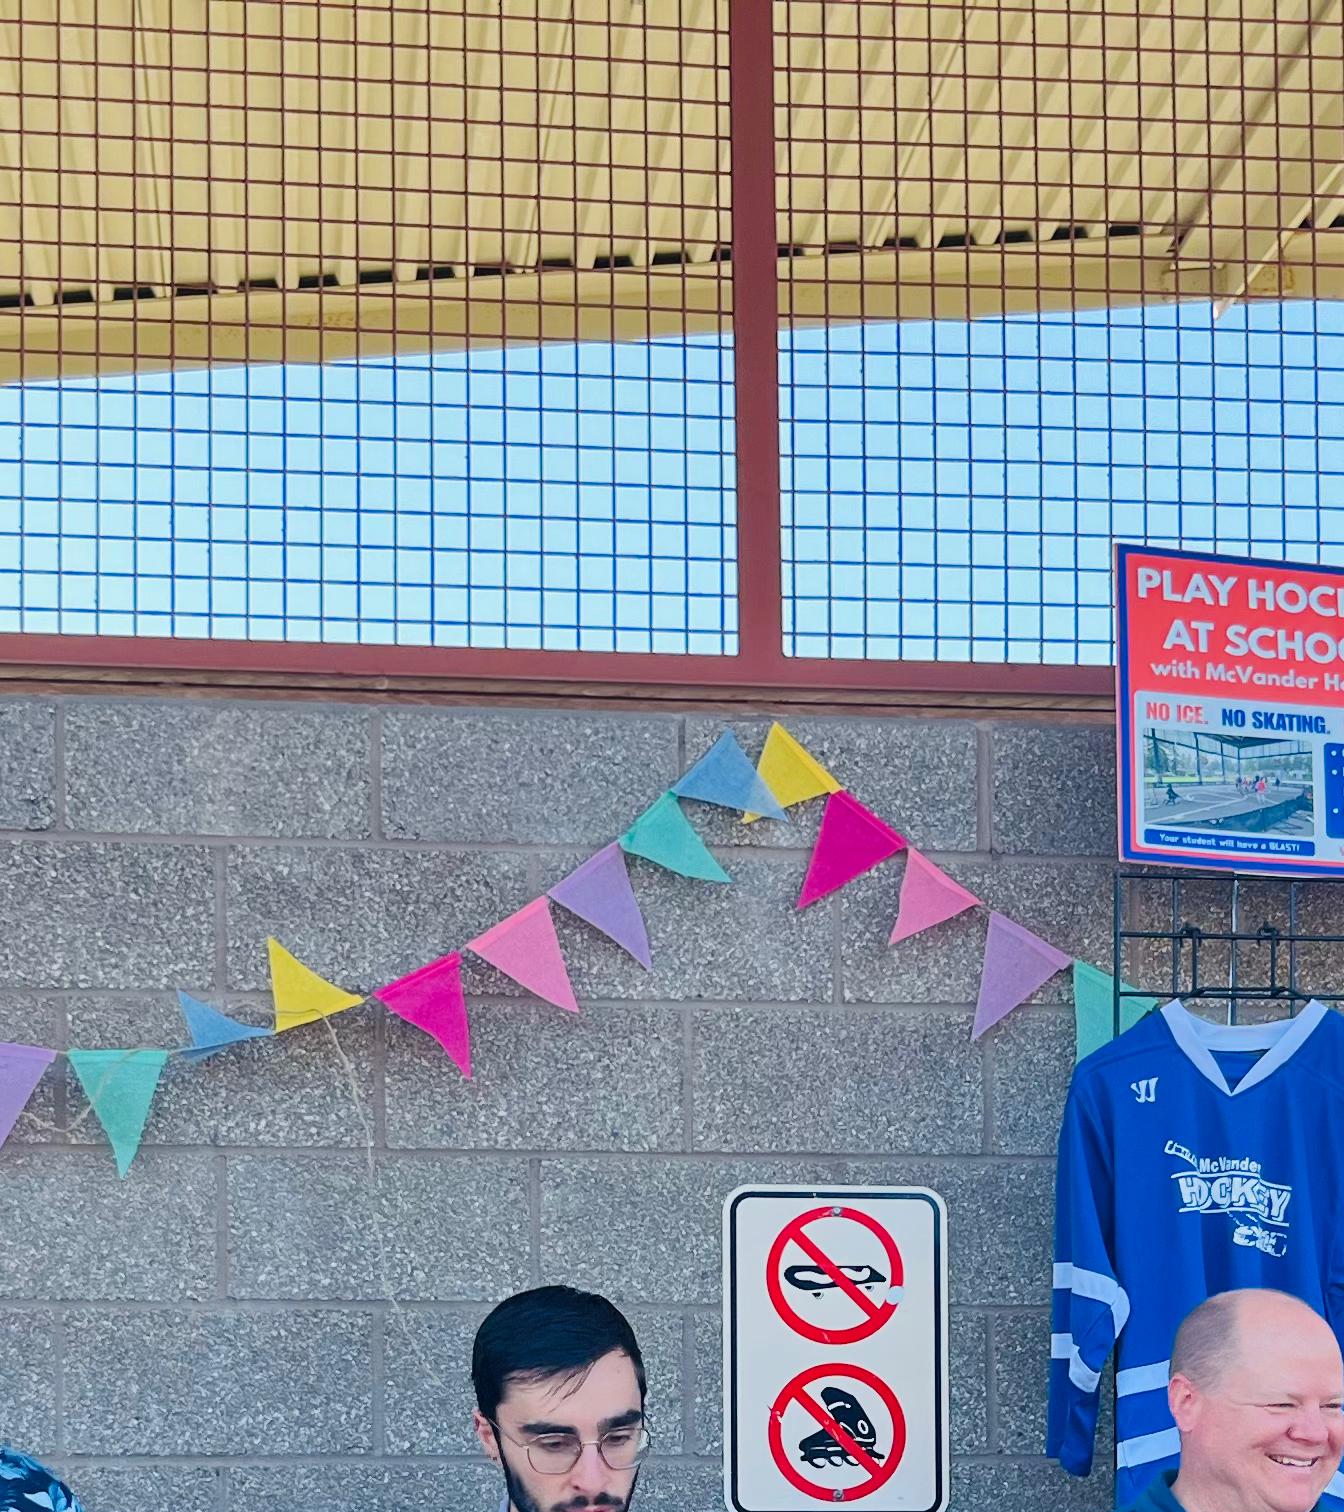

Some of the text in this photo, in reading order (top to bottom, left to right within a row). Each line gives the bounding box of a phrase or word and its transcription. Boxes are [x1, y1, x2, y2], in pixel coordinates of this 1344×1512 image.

[1137, 567, 1237, 606] PLAY
[1163, 619, 1215, 653] AT
[1151, 660, 1200, 679] with
[1206, 663, 1318, 689] McVander
[1146, 702, 1170, 721] NO
[1176, 704, 1208, 724] ICE.
[1222, 708, 1246, 727] NO
[1252, 711, 1331, 734] SKATING.
[1160, 833, 1179, 843] Your
[1182, 836, 1216, 847] student
[1219, 839, 1234, 849] will
[1237, 841, 1258, 850] have
[1178, 1177, 1291, 1221] HOCKEY
